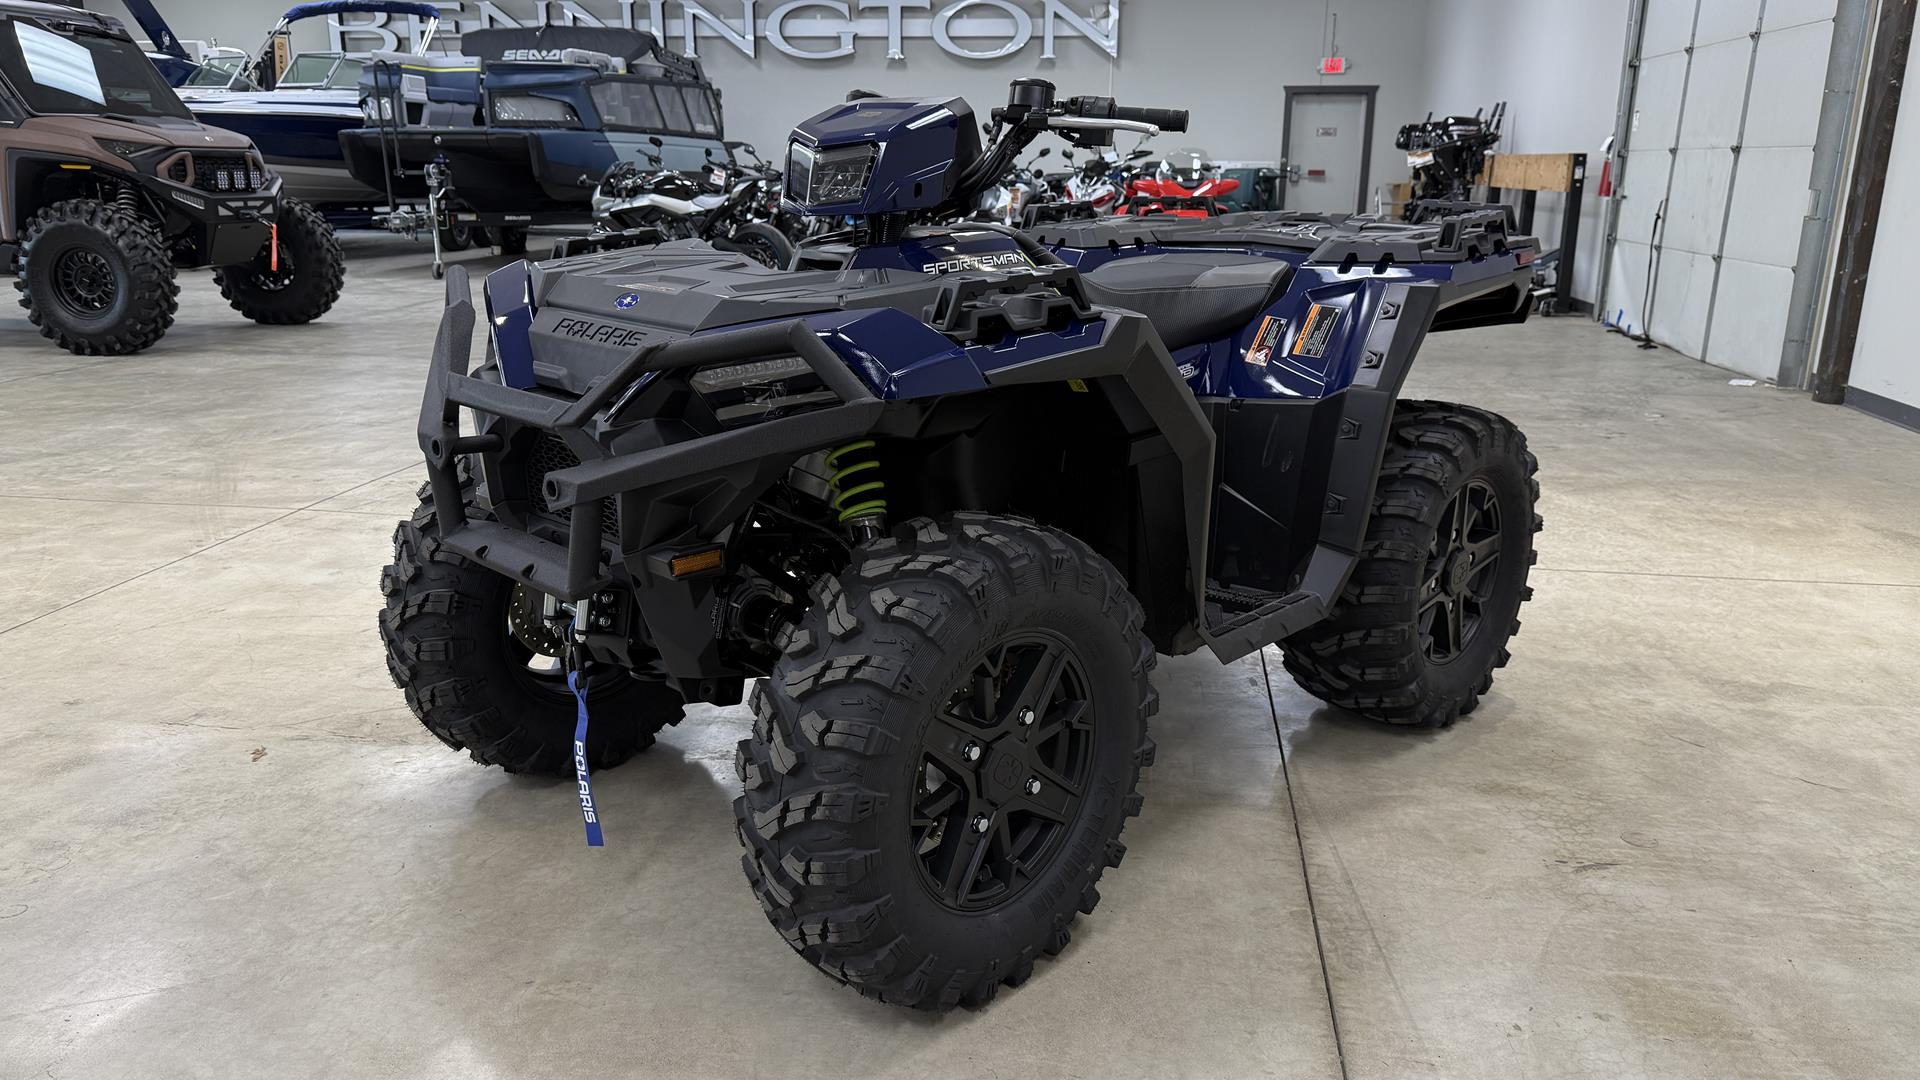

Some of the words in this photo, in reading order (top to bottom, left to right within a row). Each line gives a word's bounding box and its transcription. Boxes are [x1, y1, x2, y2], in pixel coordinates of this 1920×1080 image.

[923, 253, 1025, 275] SPORTSMAN
[551, 317, 648, 347] POLARIS
[575, 740, 597, 824] POLARIS
